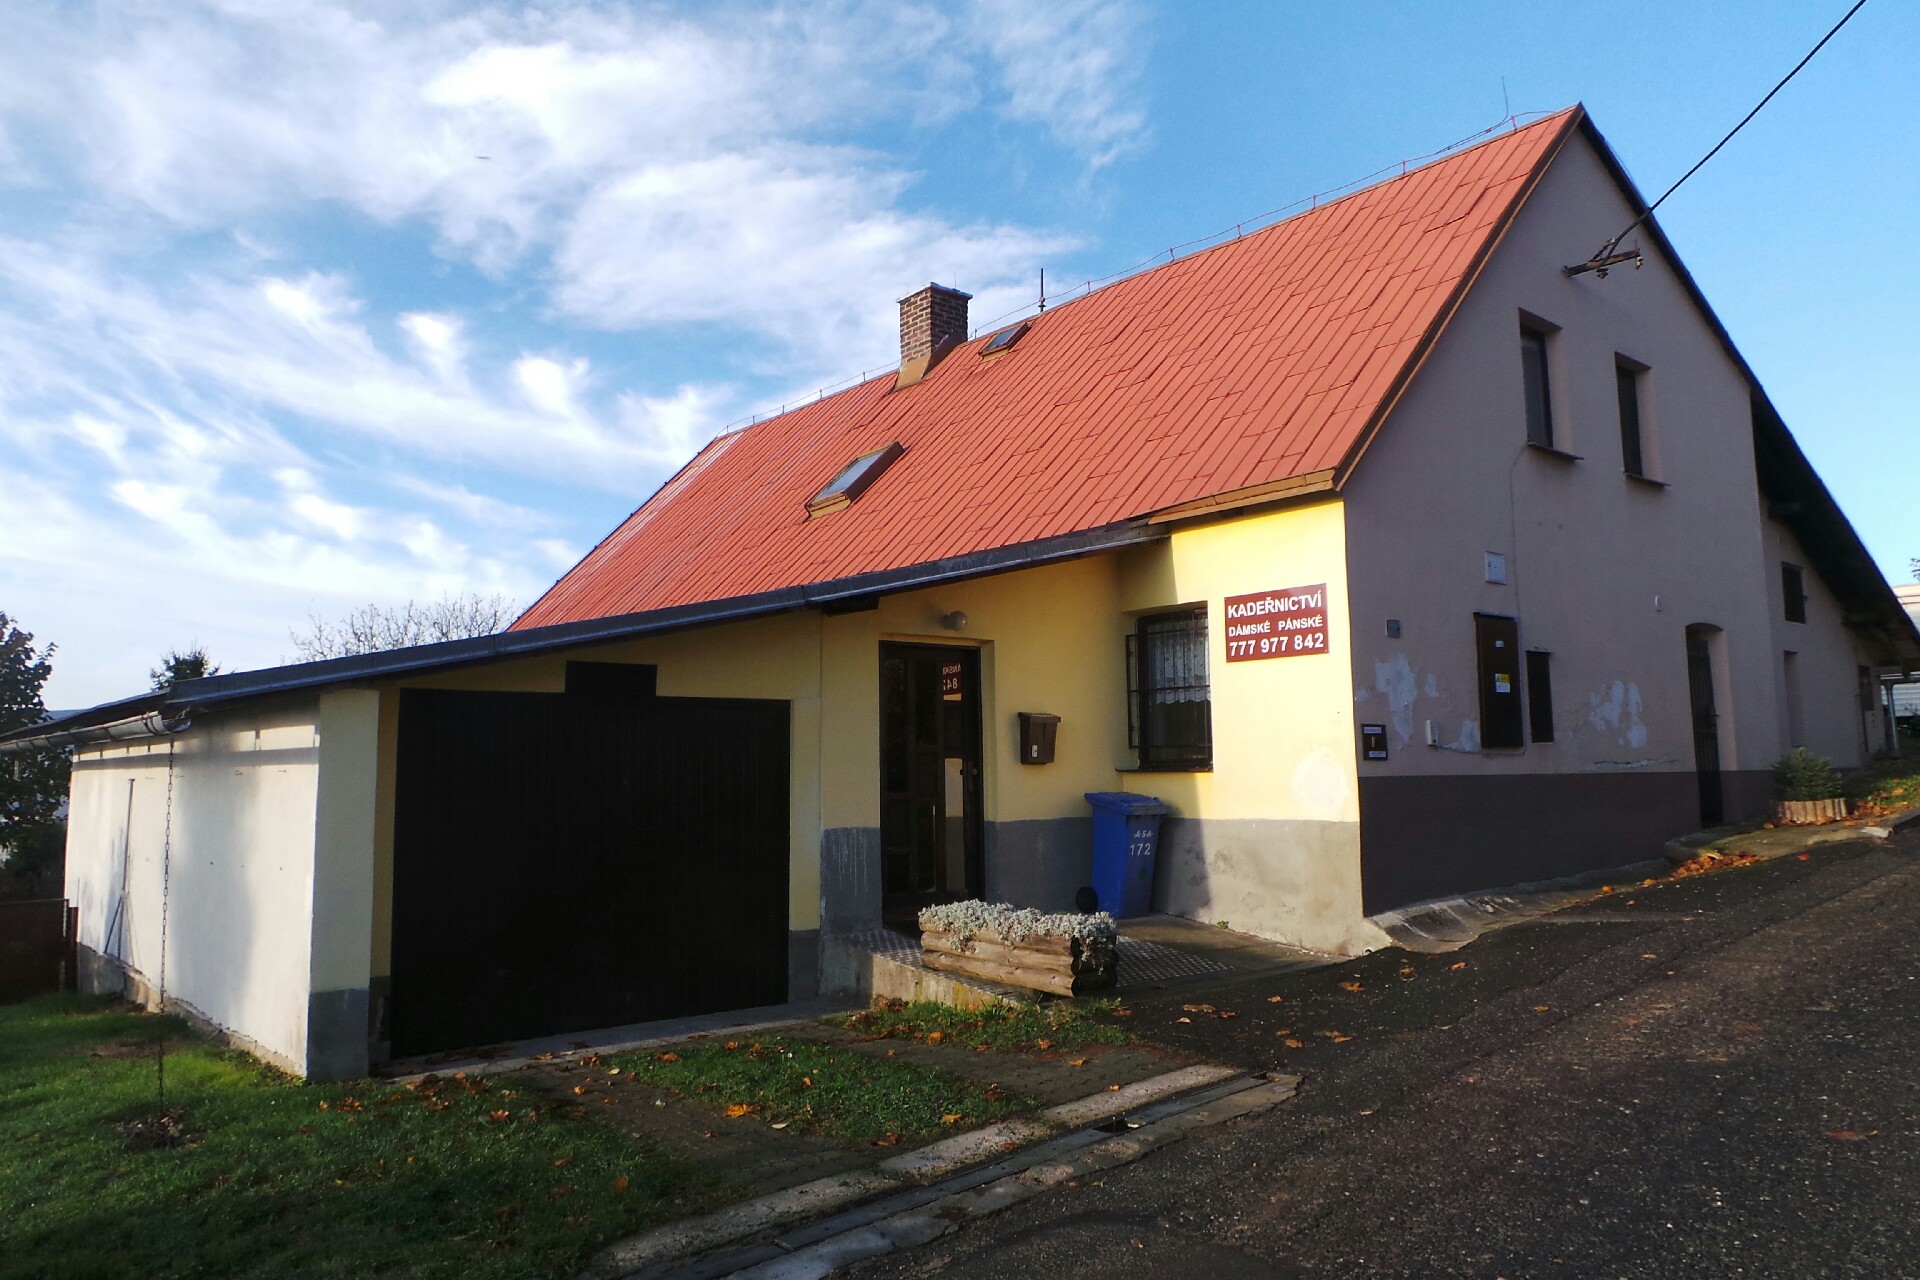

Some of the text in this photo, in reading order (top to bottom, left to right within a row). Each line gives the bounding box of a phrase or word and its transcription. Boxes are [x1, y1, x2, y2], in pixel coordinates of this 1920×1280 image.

[1228, 590, 1322, 618] KADEŘNICTVÍ
[1228, 614, 1323, 637] DÁMSKÉ PÁNSKÉ
[1229, 632, 1324, 657] 777 977 842
[1130, 843, 1151, 856] 172
